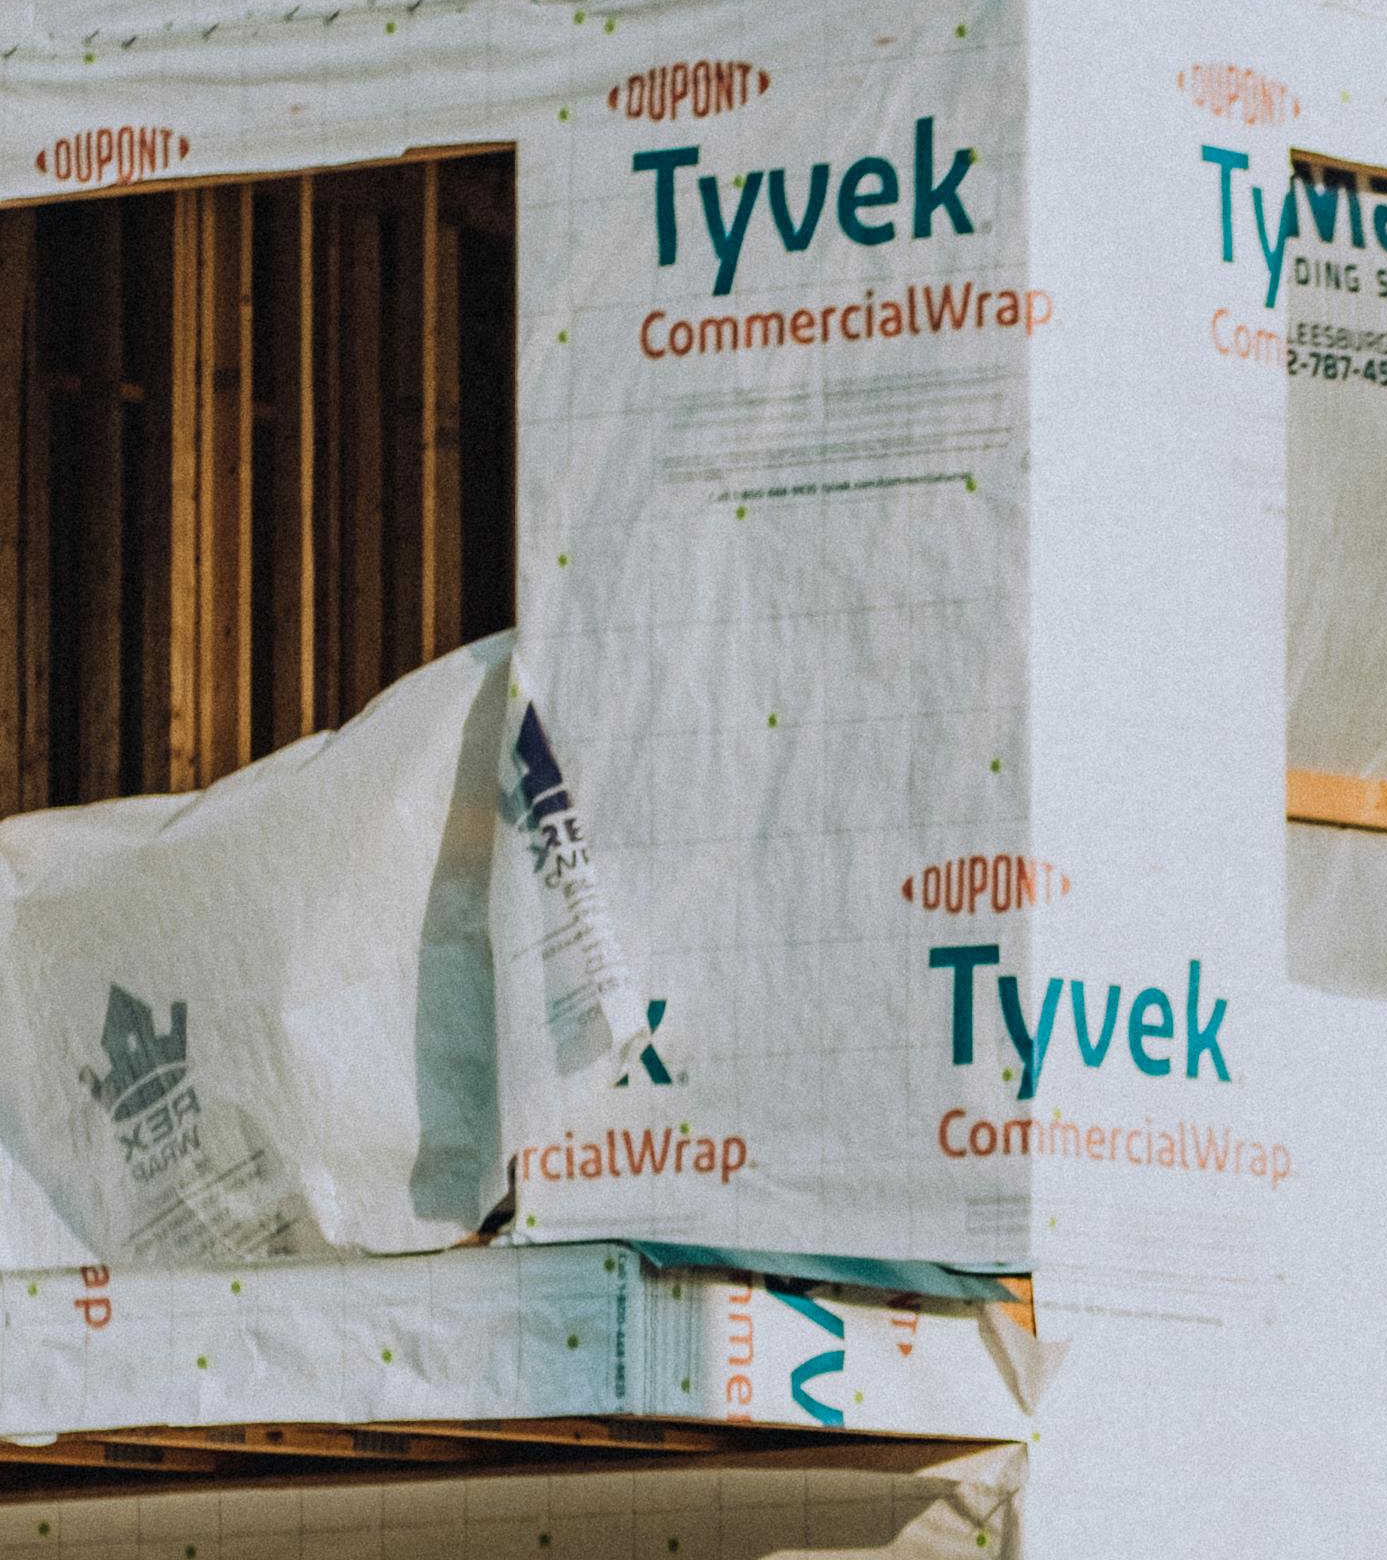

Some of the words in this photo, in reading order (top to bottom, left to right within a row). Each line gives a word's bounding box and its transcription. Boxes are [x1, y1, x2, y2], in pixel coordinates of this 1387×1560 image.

[625, 63, 754, 121] DUPONT
[53, 127, 174, 183] DUPONT
[631, 117, 975, 297] Tyvek
[640, 280, 1052, 359] CommercialWrap
[922, 855, 1056, 914] DUPONT
[928, 945, 1231, 1101] Tyvek
[939, 1109, 1292, 1191] CommercialWrap
